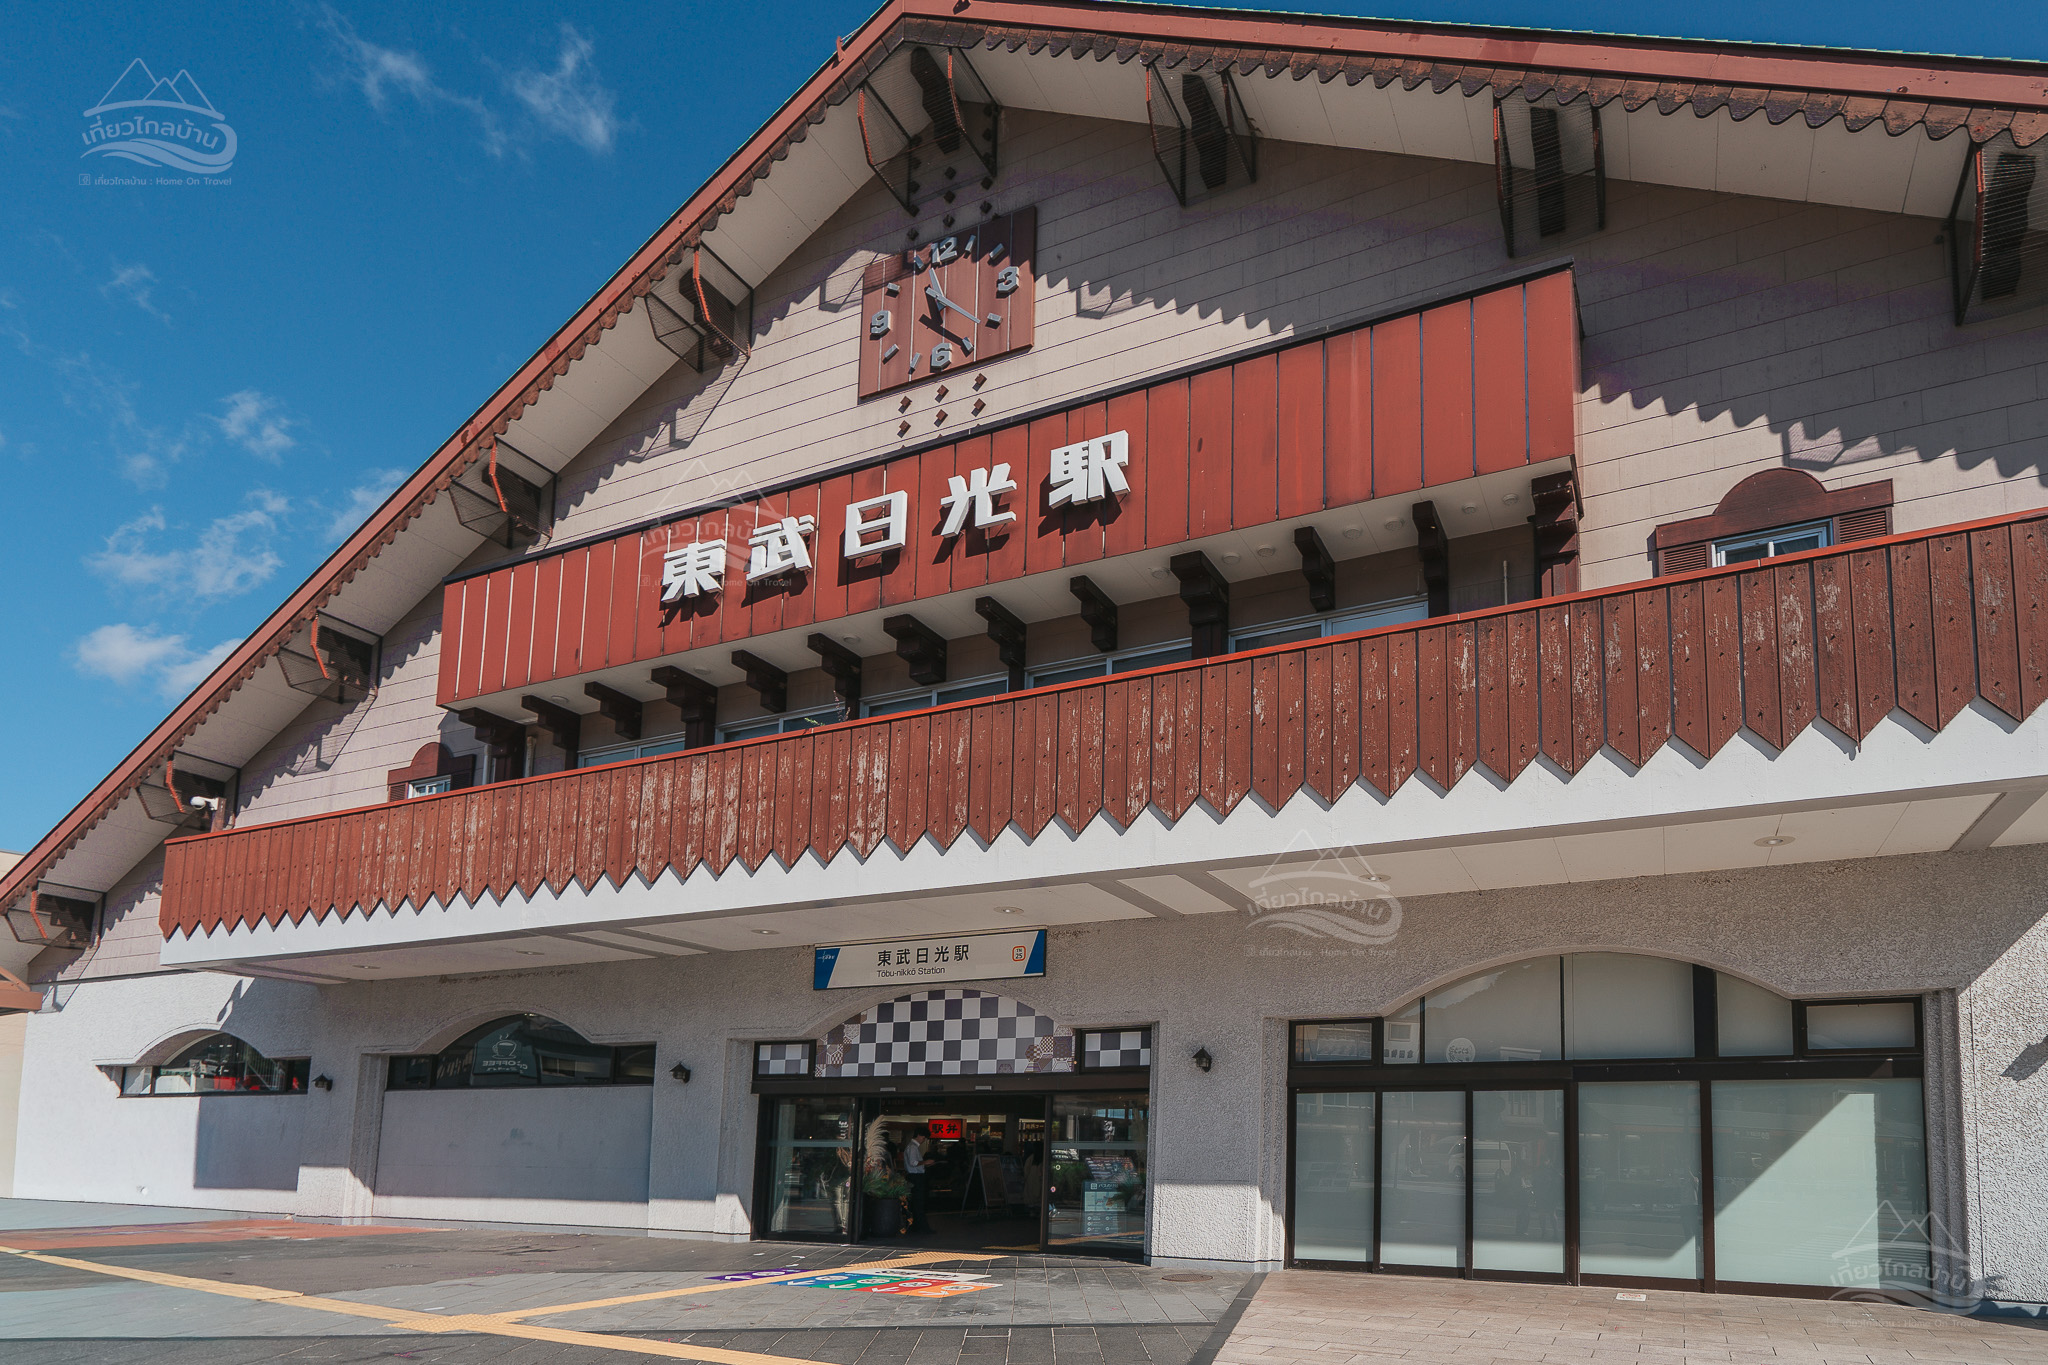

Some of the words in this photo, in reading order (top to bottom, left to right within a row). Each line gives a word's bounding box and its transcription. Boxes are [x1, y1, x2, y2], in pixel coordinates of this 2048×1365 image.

[930, 236, 958, 265] 12
[998, 266, 1020, 295] 3
[870, 310, 892, 337] 9
[930, 343, 952, 370] 6
[661, 429, 1132, 603] 東武日光駅
[877, 944, 969, 967] 東武日光駅
[918, 966, 946, 976] Station
[932, 1123, 958, 1134] 駅弁
